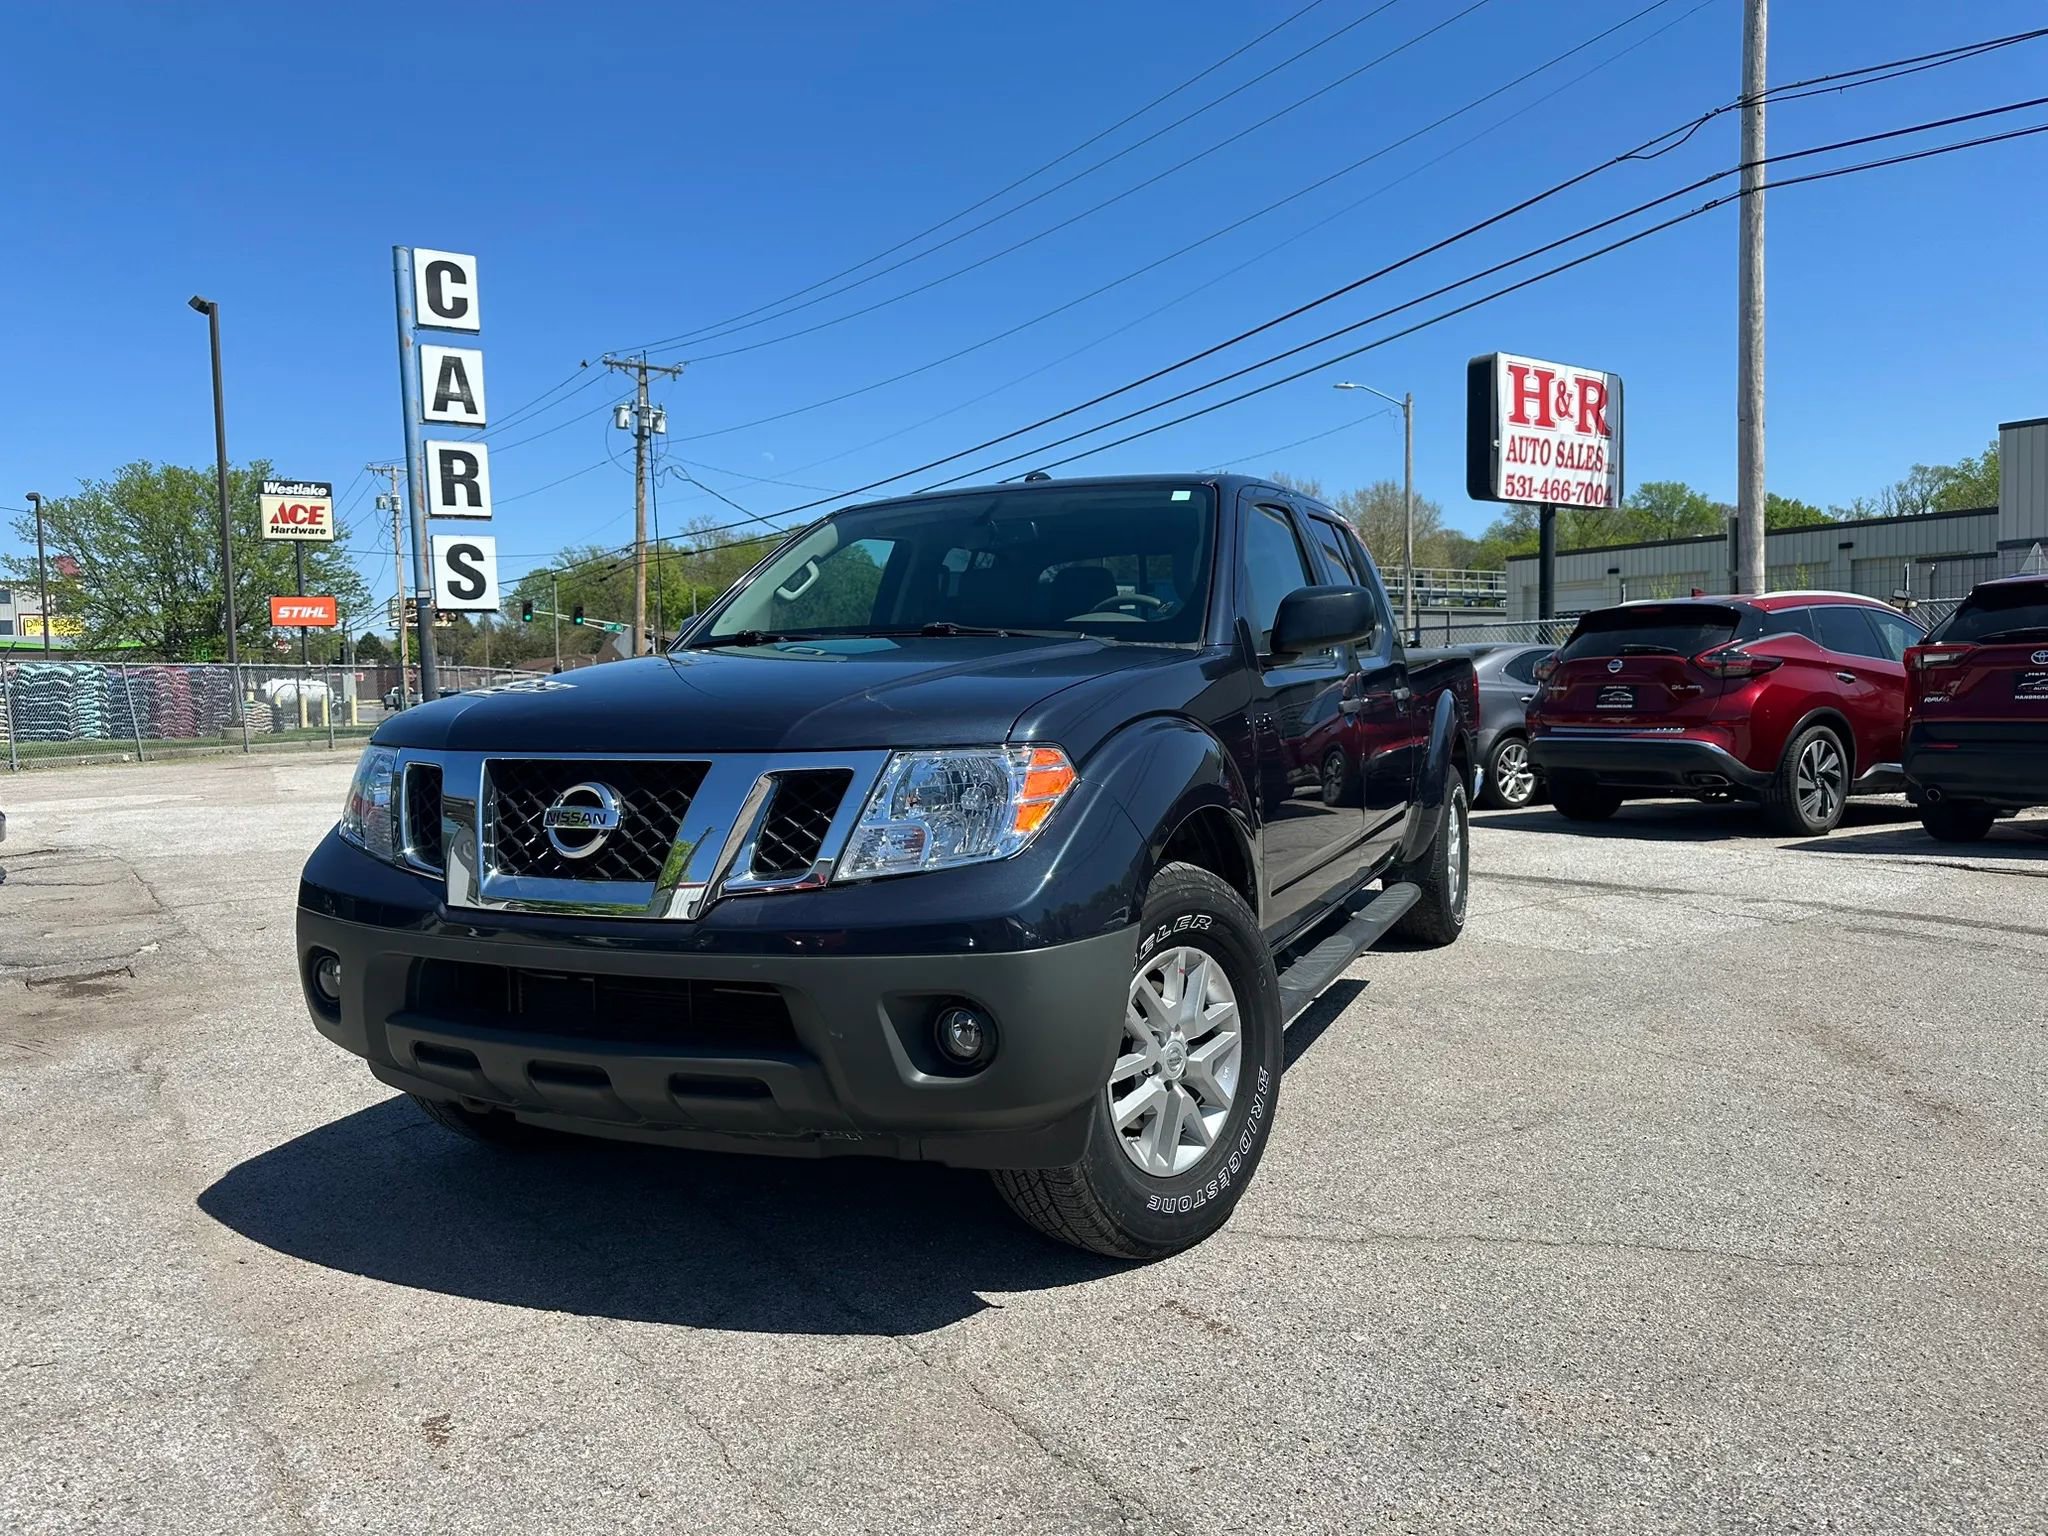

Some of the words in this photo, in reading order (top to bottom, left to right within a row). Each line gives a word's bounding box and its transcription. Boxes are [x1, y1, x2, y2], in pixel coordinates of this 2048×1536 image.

[1506, 363, 1612, 438] H&R
[425, 260, 487, 600] CARS
[1506, 435, 1551, 466] AUTO
[1555, 441, 1604, 473] SALES
[263, 482, 327, 496] Westlake
[1505, 473, 1613, 506] 531-466-7004
[270, 502, 325, 525] ACE
[270, 525, 327, 535] Hardware
[277, 606, 329, 618] STIHL
[547, 811, 607, 825] NISSAN
[1147, 1066, 1270, 1213] BRIDGESTONE
